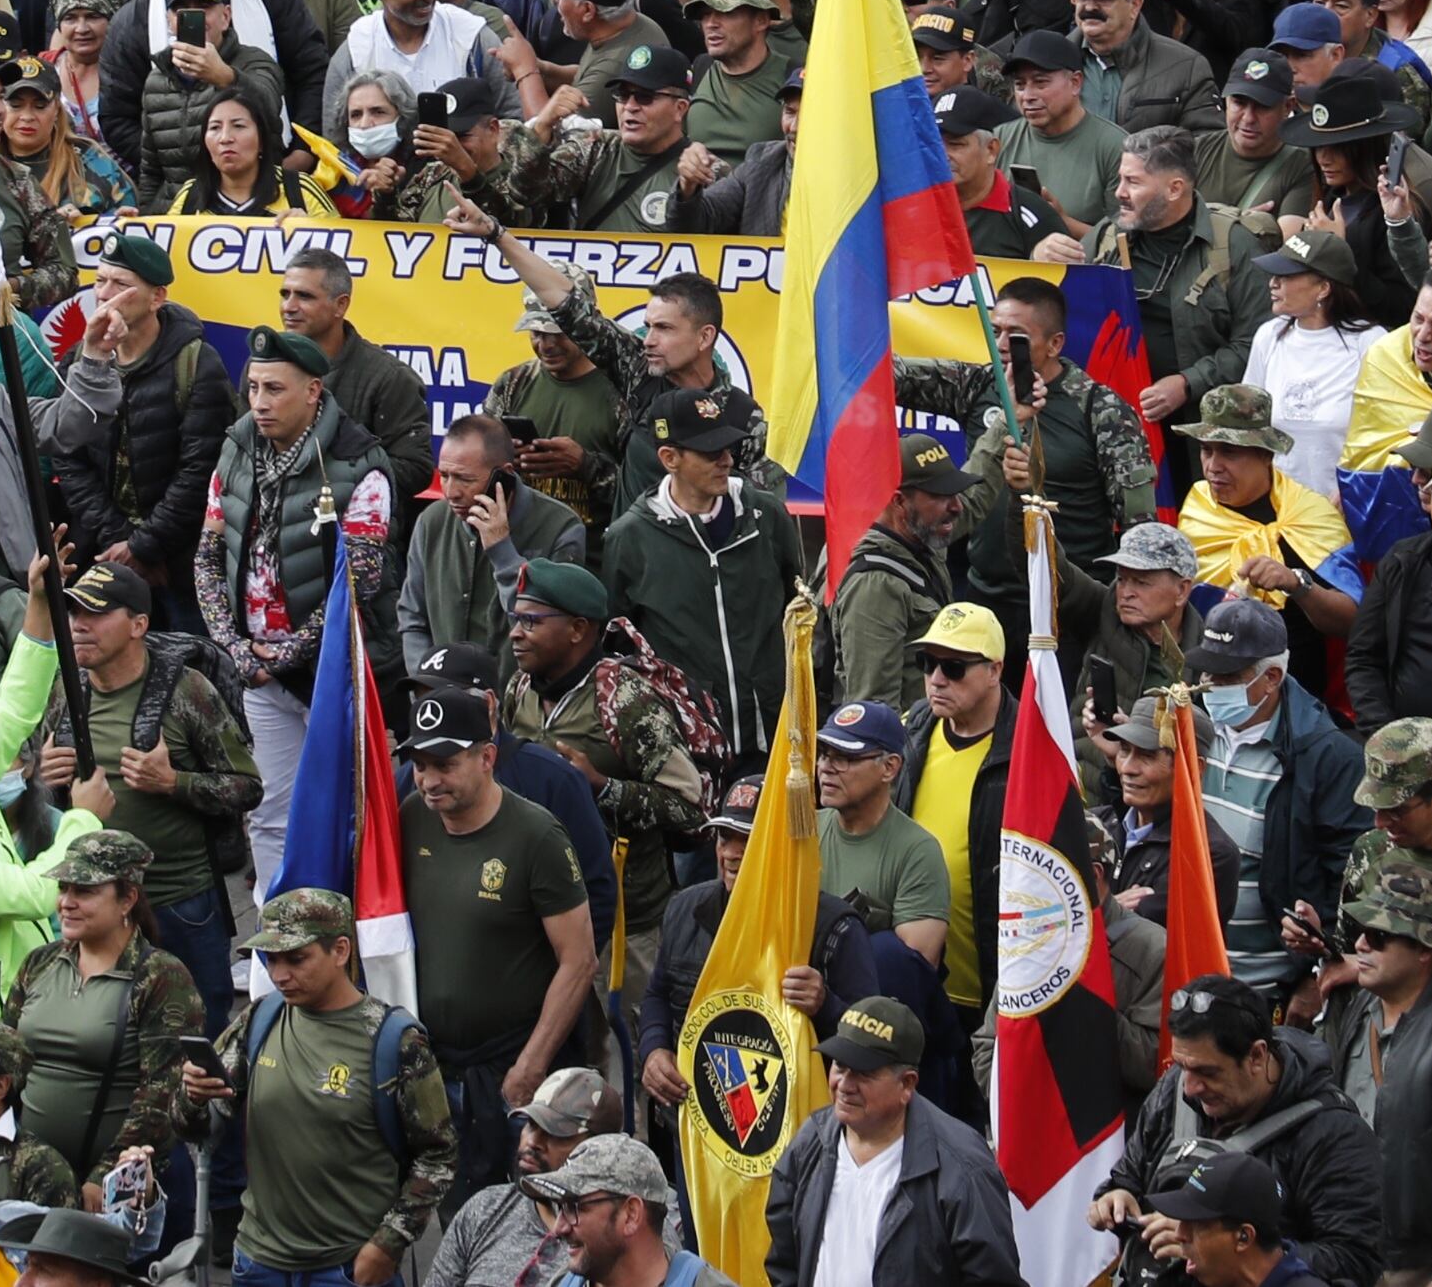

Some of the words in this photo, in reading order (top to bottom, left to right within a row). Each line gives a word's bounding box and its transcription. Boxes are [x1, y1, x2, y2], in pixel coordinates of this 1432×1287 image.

[189, 224, 368, 275] CIVIL
[385, 231, 435, 279] Y
[478, 890, 501, 901] BRASIL
[1003, 838, 1085, 932] TERNACIONAL
[724, 994, 740, 1008] DE
[702, 1062, 735, 1132] PROGRESO
[725, 1149, 757, 1173] RETIRO
